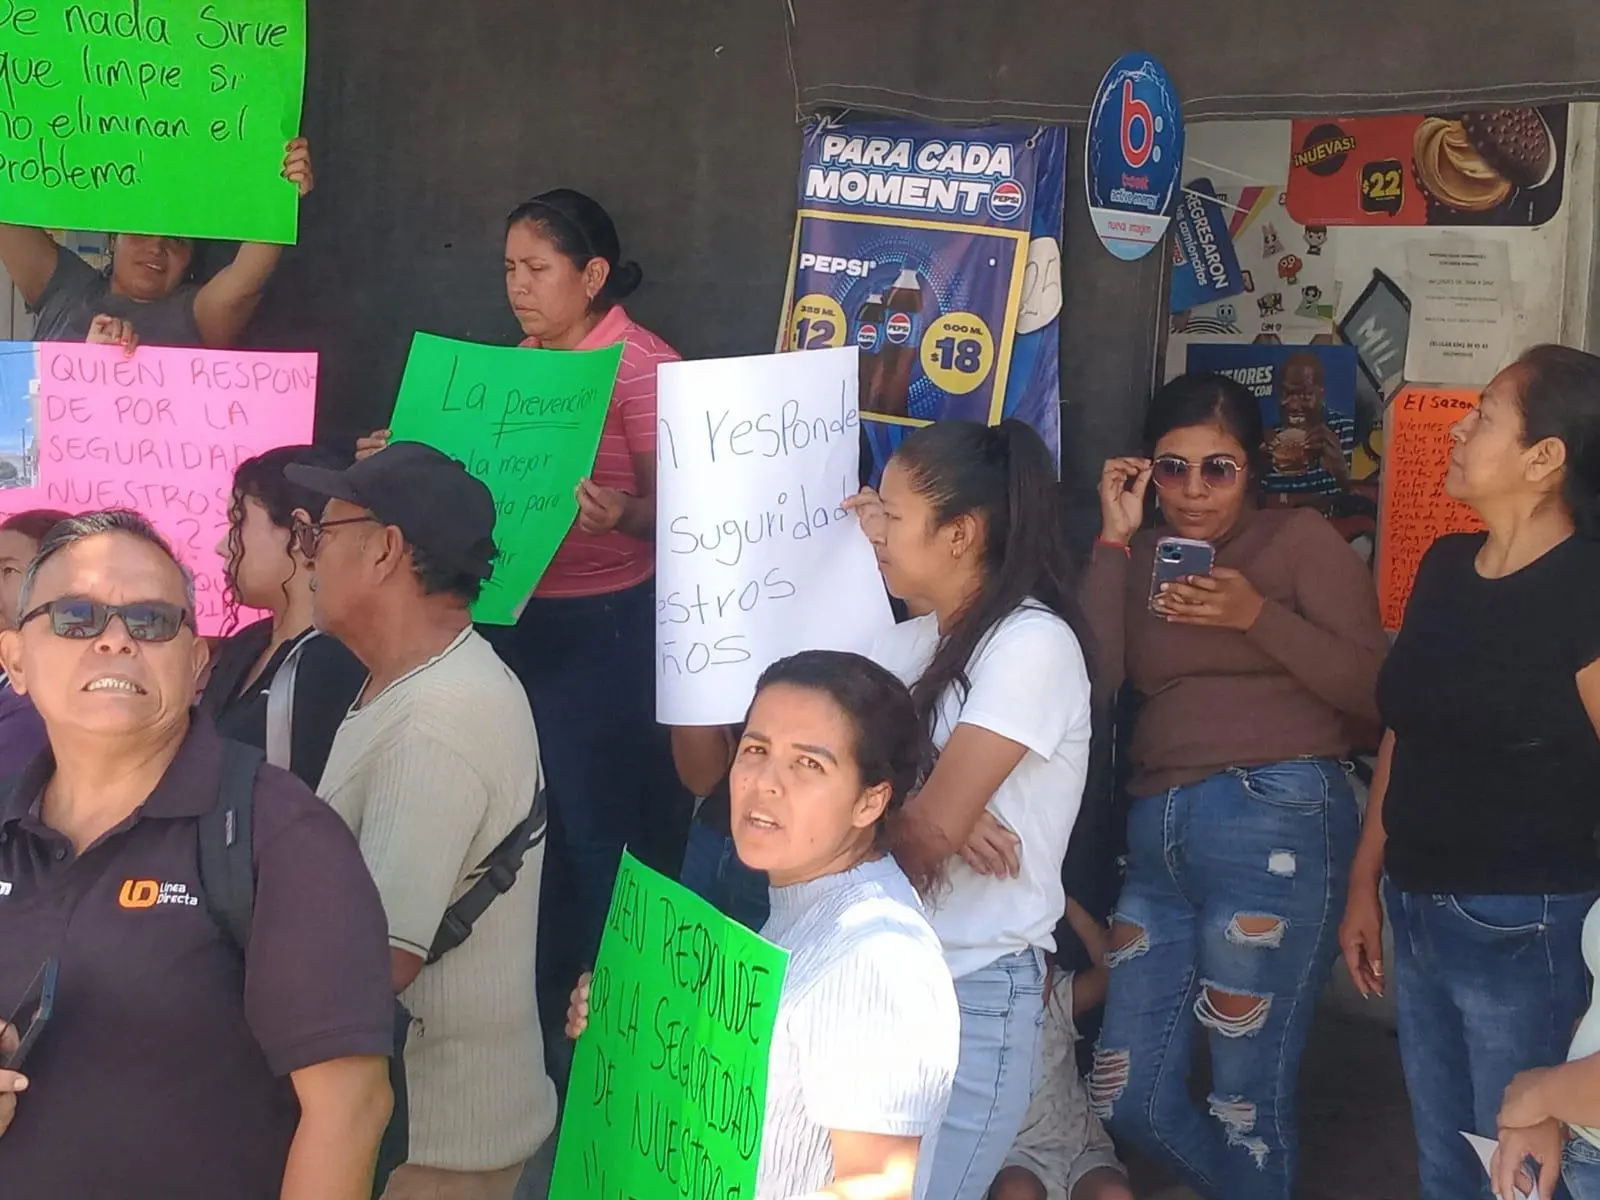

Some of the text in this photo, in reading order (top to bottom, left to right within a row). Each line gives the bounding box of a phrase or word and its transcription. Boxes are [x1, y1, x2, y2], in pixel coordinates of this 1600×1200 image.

[65, 0, 171, 46] nada
[0, 51, 61, 110] que
[83, 45, 182, 100] limpie
[48, 96, 190, 139] eliminan
[210, 105, 248, 141] el
[820, 136, 1014, 177] PARA CADA
[1295, 137, 1356, 167] ¡NUEVAS!
[1184, 191, 1230, 290] REGRESARON
[799, 253, 870, 278] PEPSI
[50, 353, 165, 389] QUIEN
[930, 336, 982, 375] $18
[441, 355, 488, 412] La
[1404, 394, 1425, 412] El
[45, 394, 250, 430] DE POR LA
[659, 896, 770, 1045] RESPONDE
[592, 1045, 617, 1128] DE
[617, 981, 641, 1057] LA
[650, 996, 760, 1161] SEGURIDAD
